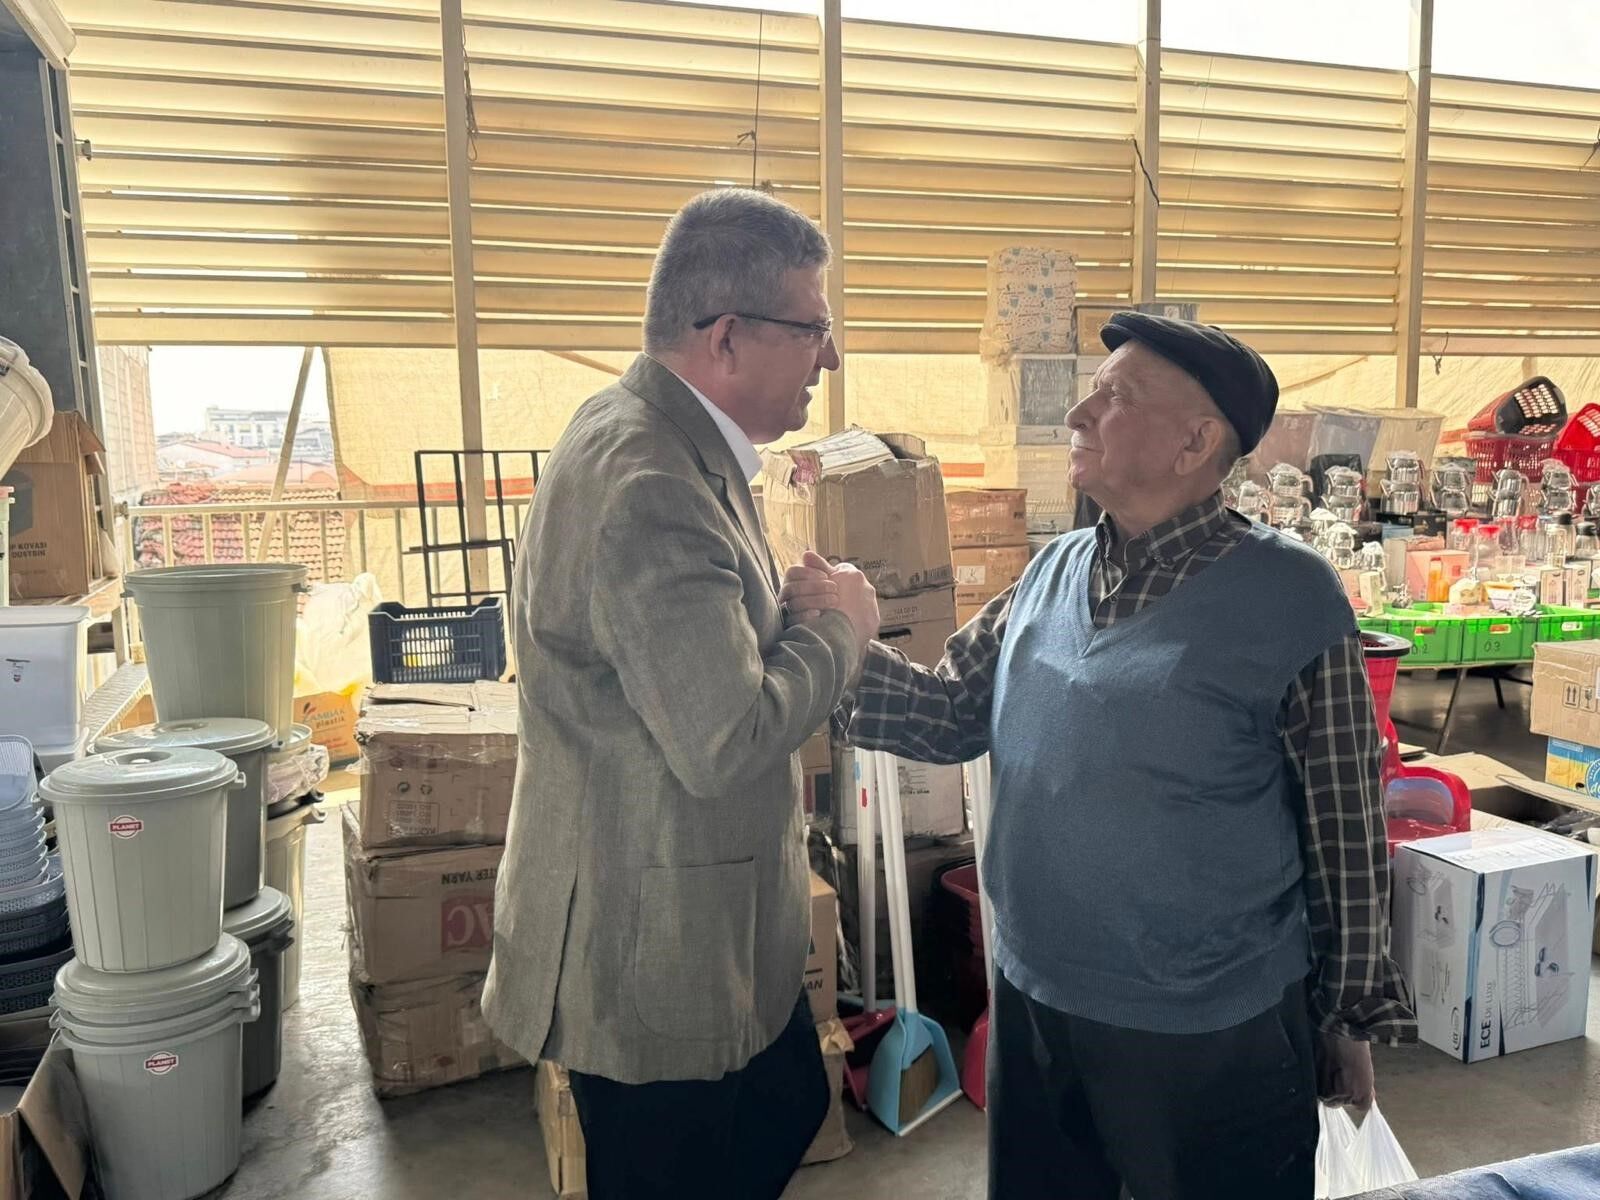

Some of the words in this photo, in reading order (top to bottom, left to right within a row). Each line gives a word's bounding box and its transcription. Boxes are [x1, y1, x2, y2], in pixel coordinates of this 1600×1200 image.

[111, 822, 141, 831] PLANET
[441, 872, 474, 886] YARN
[475, 869, 498, 882] TER
[1480, 1020, 1491, 1049] ECE
[146, 1057, 176, 1068] PLANET
